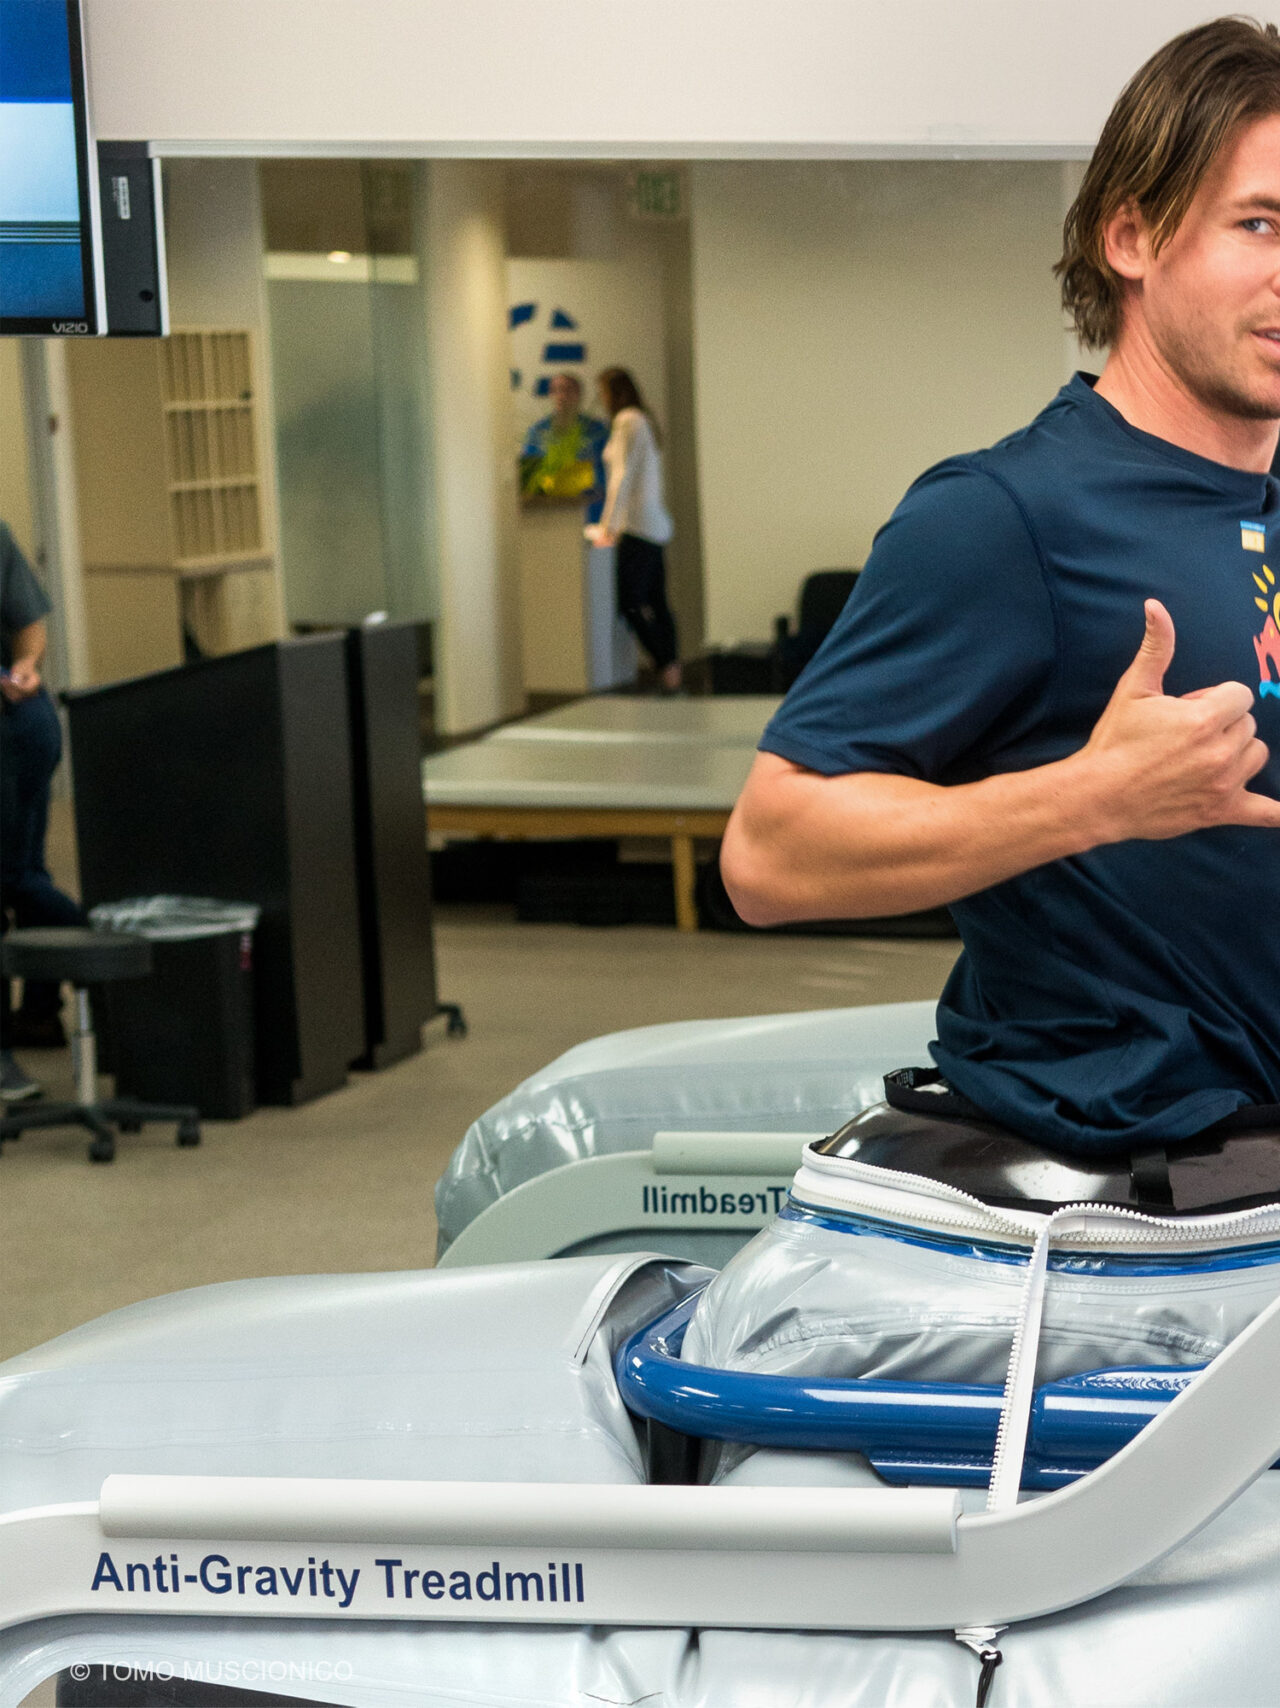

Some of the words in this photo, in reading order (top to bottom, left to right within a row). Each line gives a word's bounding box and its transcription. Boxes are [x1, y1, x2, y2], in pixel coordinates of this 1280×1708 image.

[52, 321, 89, 334] VIZIO
[90, 1551, 361, 1609] Anti-Gravity
[375, 1558, 585, 1604] Treadmill
